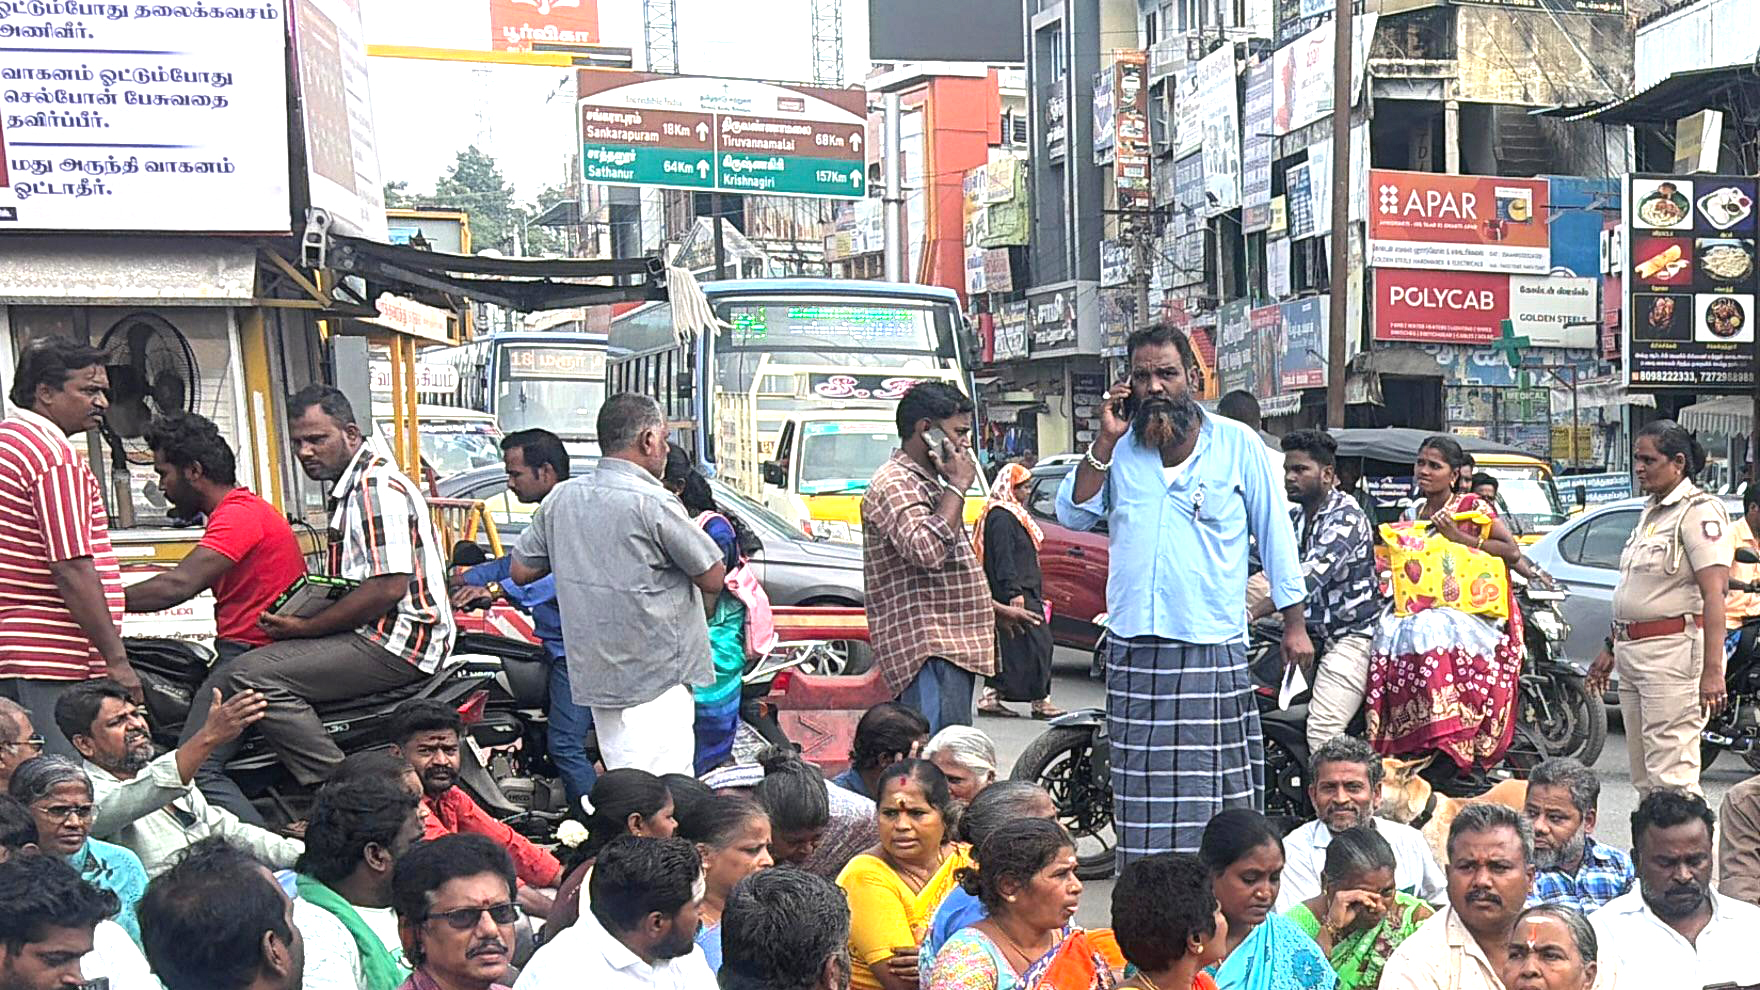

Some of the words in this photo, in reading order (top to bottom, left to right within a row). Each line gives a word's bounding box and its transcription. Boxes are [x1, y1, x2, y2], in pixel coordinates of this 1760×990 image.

[134, 2, 278, 20] தலைக்கவசம்
[0, 22, 94, 39] அணிவீர்.
[2, 65, 93, 81] வாகனம்
[100, 66, 233, 87] ஓட்டும்போது
[4, 86, 117, 105] செல்போன்
[125, 91, 228, 109] பேசுவதை
[7, 110, 109, 129] தவிர்ப்பீர்.
[587, 125, 659, 142] Sankarapuram
[663, 123, 690, 137] 18Km
[722, 134, 796, 151] Tiruvannamalai
[815, 133, 845, 147] 68Km
[12, 160, 52, 175] மது
[59, 155, 139, 175] அருந்தி
[145, 157, 235, 174] வாகனம்
[588, 165, 634, 180] Sathanur
[663, 160, 694, 174] 64Km
[14, 178, 112, 200] ஓட்டாதீர்.
[723, 173, 775, 189] Krishnagiri
[815, 170, 847, 183] 157Km
[1403, 189, 1477, 219] APAR
[1390, 286, 1494, 311] POLYCAB
[1519, 313, 1555, 323] GOLDEN
[1505, 391, 1547, 400] MEDICAL
